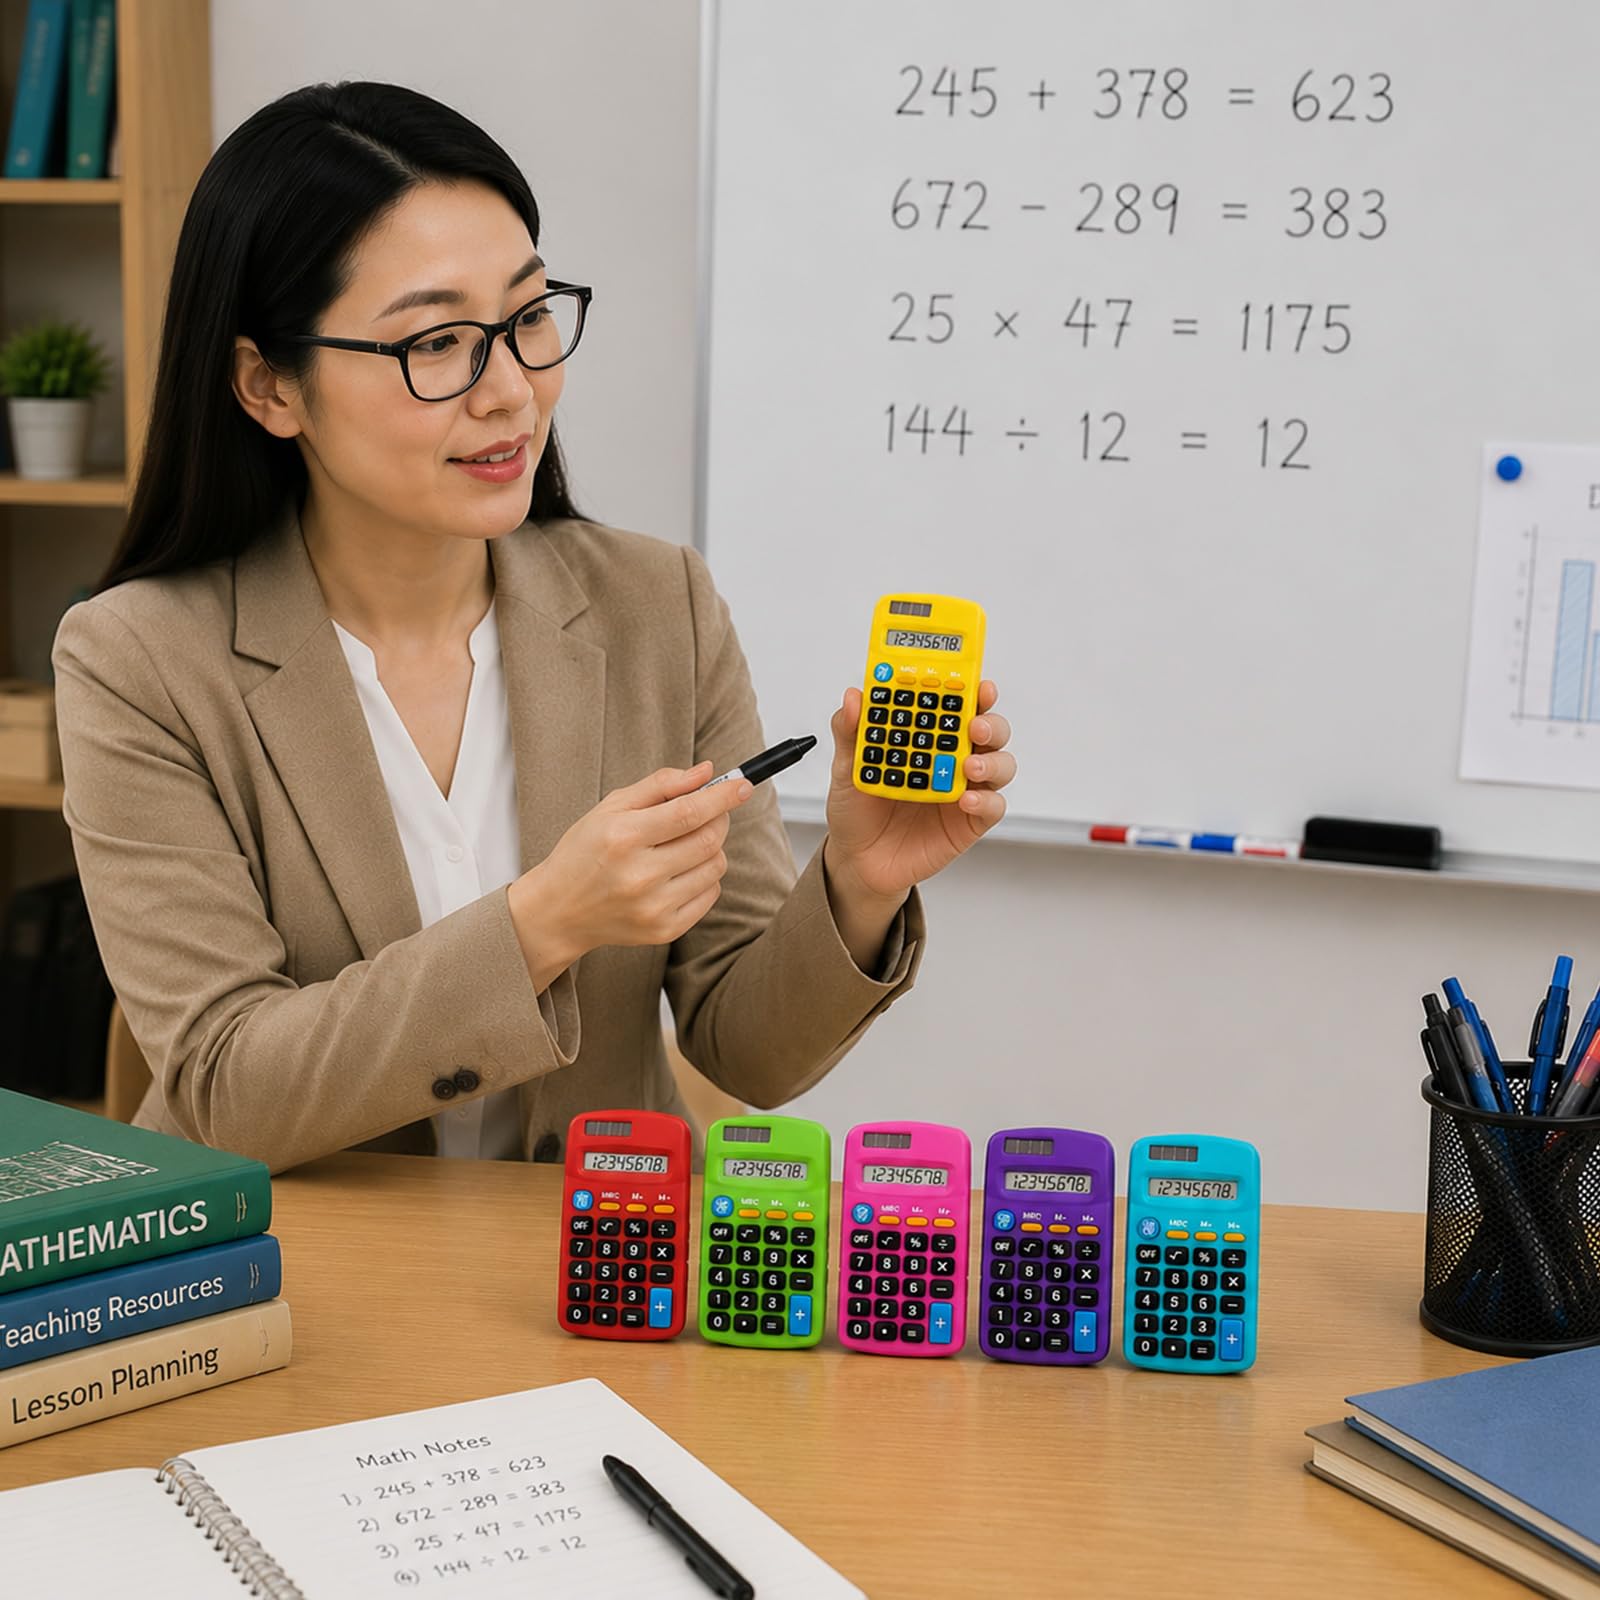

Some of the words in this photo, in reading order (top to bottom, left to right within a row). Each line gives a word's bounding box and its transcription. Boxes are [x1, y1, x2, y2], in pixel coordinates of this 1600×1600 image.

[896, 65, 998, 117] 245
[1029, 80, 1055, 110] +
[1094, 68, 1187, 119] 378
[1229, 89, 1254, 104] =
[1292, 69, 1394, 122] 623
[892, 179, 989, 230] 672
[1076, 183, 1179, 235] 289
[1223, 203, 1247, 219] =
[1285, 188, 1386, 239] 383
[889, 293, 955, 343] 25
[995, 312, 1018, 338] ×
[1064, 298, 1132, 348] 47
[1173, 320, 1198, 335] =
[1240, 303, 1351, 353] 1175
[884, 404, 973, 456] 144
[1006, 418, 1039, 451] ÷
[1080, 411, 1129, 460] 12
[1182, 432, 1206, 448] =
[1258, 418, 1310, 469] 12
[874, 709, 882, 720] 7
[896, 711, 905, 724] 8
[920, 714, 929, 726] 9
[870, 729, 878, 741] 4
[917, 734, 926, 746] 6
[869, 749, 875, 760] 1
[891, 751, 900, 764] 2
[865, 769, 874, 780] 0
[573, 1220, 588, 1230] OFF
[713, 1227, 728, 1237] OFF
[853, 1234, 869, 1244] OFF
[576, 1241, 584, 1253] 7
[602, 1243, 611, 1255] 8
[629, 1244, 639, 1257] 9
[716, 1248, 724, 1260] 7
[743, 1249, 752, 1262] 8
[769, 1251, 778, 1264] 9
[1139, 1249, 1156, 1258] OFF
[856, 1255, 865, 1267] 7
[882, 1257, 892, 1270] 8
[574, 1264, 583, 1276] 4
[601, 1265, 610, 1278] 5
[628, 1267, 637, 1279] 6
[714, 1270, 723, 1283] 4
[741, 1272, 750, 1285] 5
[768, 1274, 777, 1286] 6
[998, 1263, 1006, 1275] 7
[1025, 1265, 1034, 1277] 8
[1053, 1266, 1062, 1279] 9
[1143, 1271, 1151, 1282] 7
[575, 1286, 580, 1297] 1
[601, 1288, 610, 1300] 2
[628, 1289, 637, 1301] 3
[855, 1279, 863, 1291] 4
[881, 1280, 890, 1292] 5
[909, 1282, 918, 1293] 6
[996, 1286, 1005, 1298] 4
[1024, 1288, 1033, 1300] 5
[1051, 1289, 1061, 1302] 6
[715, 1293, 721, 1305] 1
[740, 1295, 749, 1308] 2
[768, 1296, 777, 1309] 3
[1142, 1294, 1151, 1306] 4
[1170, 1295, 1179, 1308] 5
[1199, 1297, 1208, 1310] 6
[0, 1307, 102, 1349] eaching
[108, 1275, 224, 1321] Resources
[573, 1308, 582, 1320] 0
[855, 1302, 861, 1313] 1
[881, 1303, 890, 1315] 2
[908, 1304, 917, 1317] 3
[997, 1310, 1003, 1321] 1
[1023, 1311, 1033, 1323] 2
[1051, 1312, 1061, 1325] 3
[713, 1316, 723, 1328] 0
[853, 1323, 862, 1335] 0
[1143, 1317, 1149, 1328] 1
[1169, 1319, 1178, 1331] 2
[1198, 1320, 1207, 1333] 3
[995, 1332, 1005, 1344] 0
[1141, 1340, 1150, 1352] 0
[11, 1381, 103, 1425] Lesson
[111, 1347, 219, 1396] Planning
[356, 1448, 417, 1469] Math
[424, 1435, 491, 1456] Notes
[374, 1481, 416, 1499] 245
[441, 1468, 480, 1486] 378
[509, 1456, 546, 1472] 623
[395, 1507, 436, 1525] 672
[460, 1494, 498, 1512] 289
[526, 1480, 565, 1498] 383
[414, 1535, 443, 1551] 25
[475, 1522, 502, 1536] 47
[534, 1506, 581, 1527] 1175
[433, 1560, 471, 1578] 144
[504, 1548, 529, 1563] 12
[561, 1535, 587, 1550] 12
